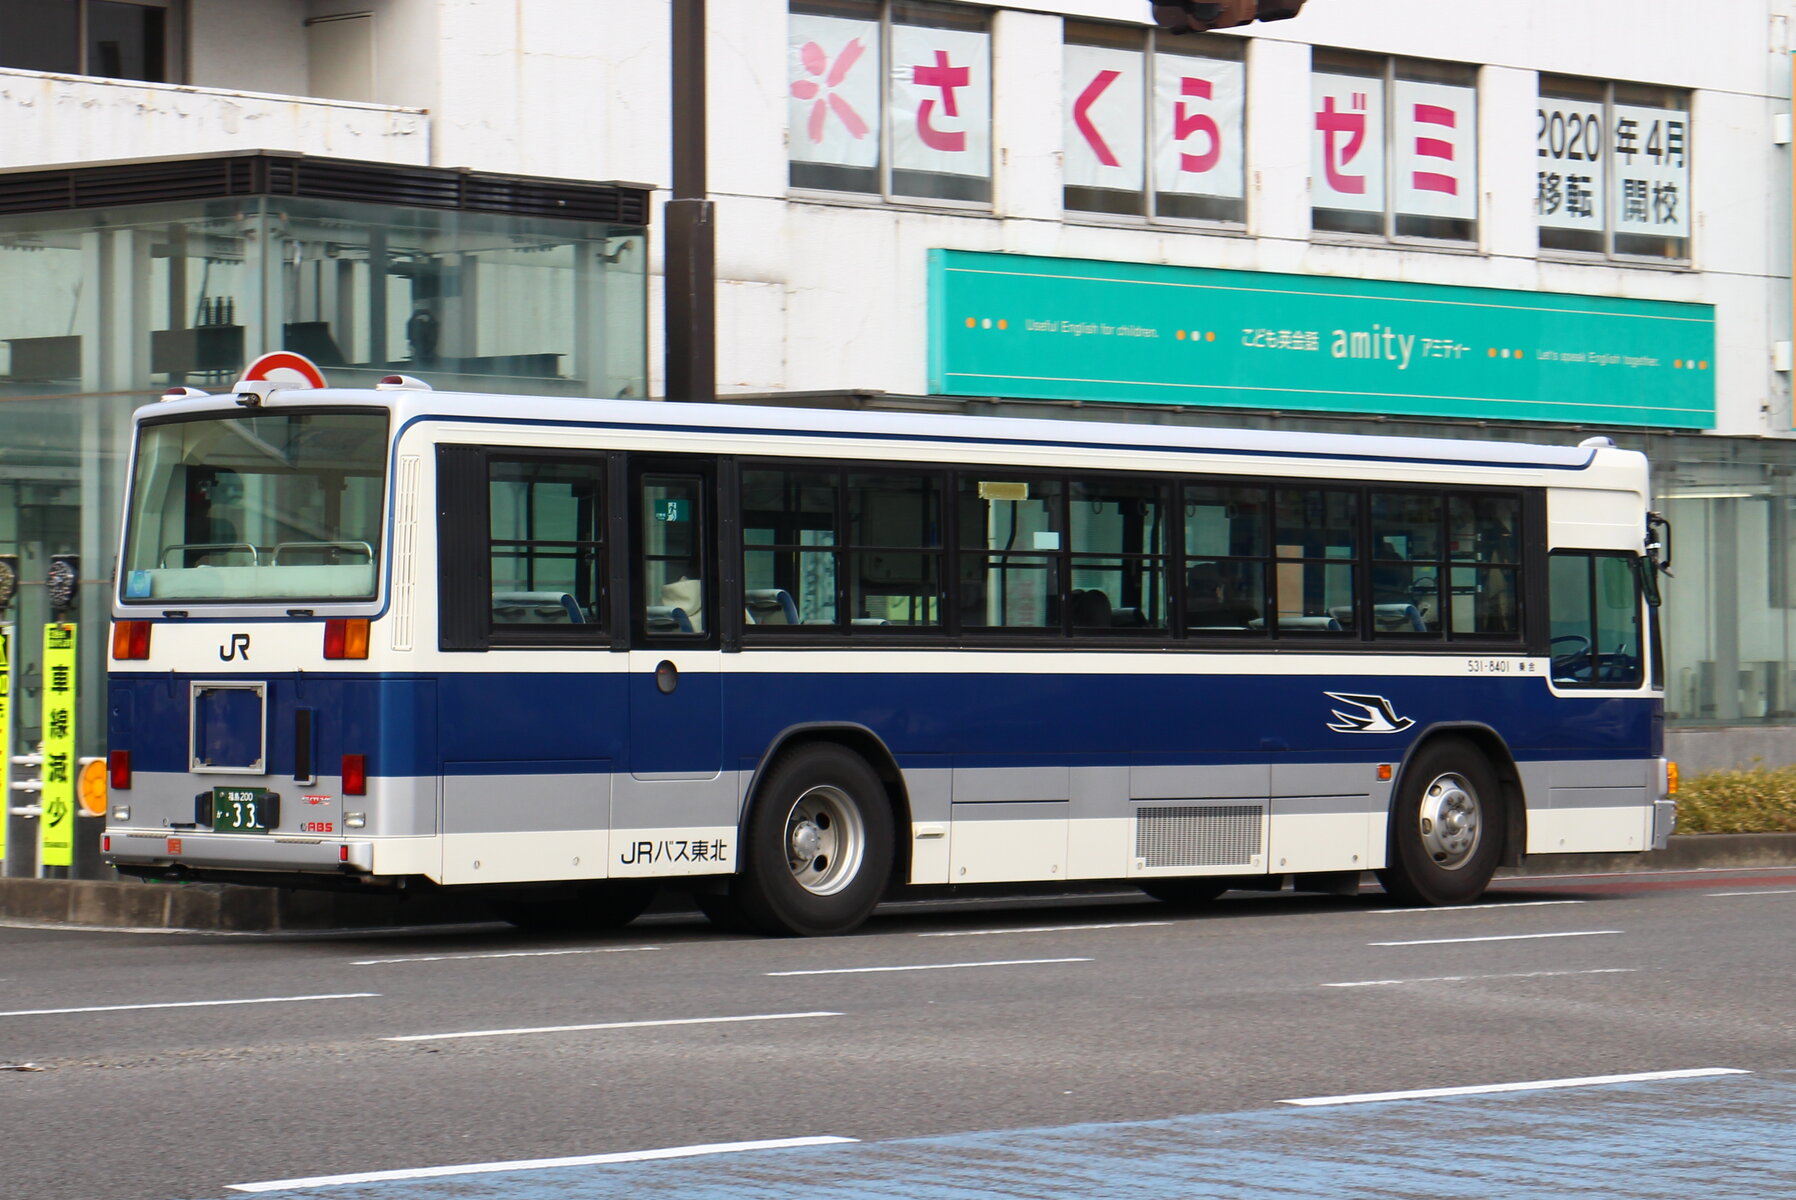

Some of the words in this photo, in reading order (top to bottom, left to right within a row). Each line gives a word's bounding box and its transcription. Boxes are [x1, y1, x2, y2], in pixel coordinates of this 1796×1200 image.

[1061, 320, 1098, 336] English
[1331, 324, 1415, 370] amity
[219, 633, 250, 662] JR
[1467, 660, 1510, 672] 531-8401
[308, 822, 333, 832] ABS
[620, 839, 728, 864] JRバス東北
